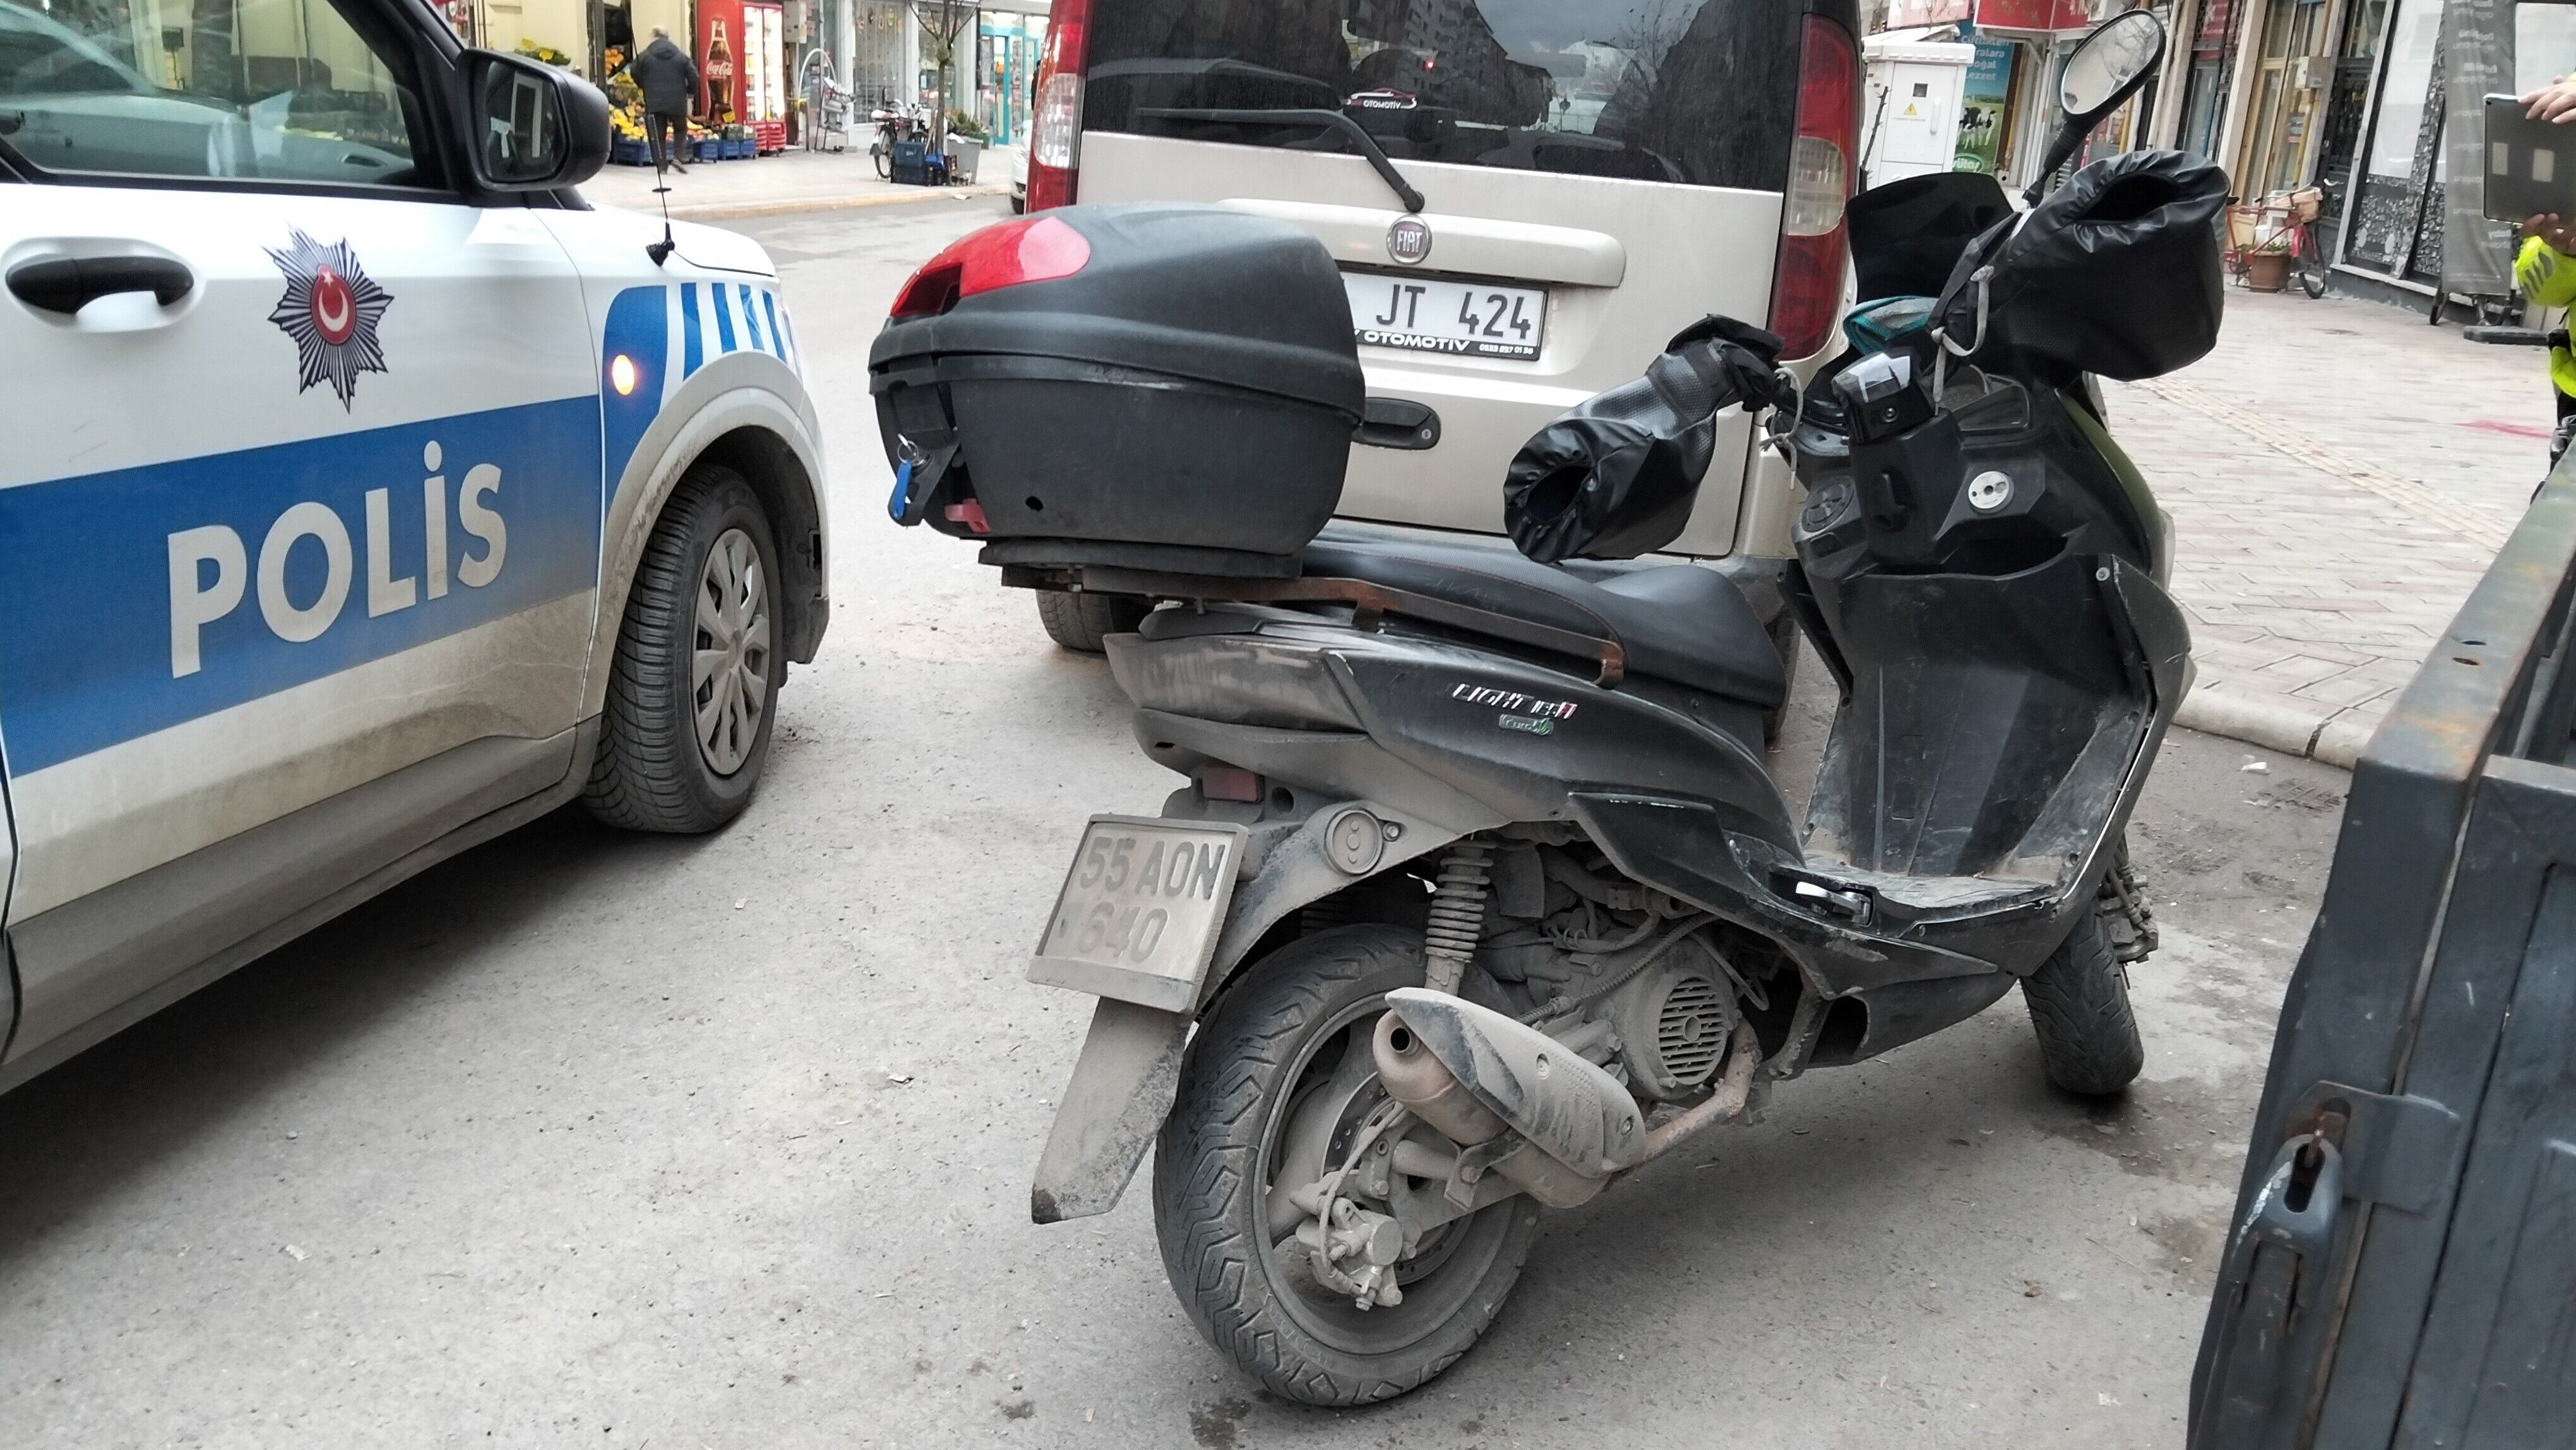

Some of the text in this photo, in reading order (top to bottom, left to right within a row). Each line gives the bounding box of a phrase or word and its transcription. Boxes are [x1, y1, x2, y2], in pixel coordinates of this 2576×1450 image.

[1397, 230, 1422, 253] FIAT
[1376, 284, 1531, 340] JT 424
[168, 440, 507, 679] POLİS
[1080, 836, 1226, 901] 55 AON
[1078, 901, 1169, 964] 640
